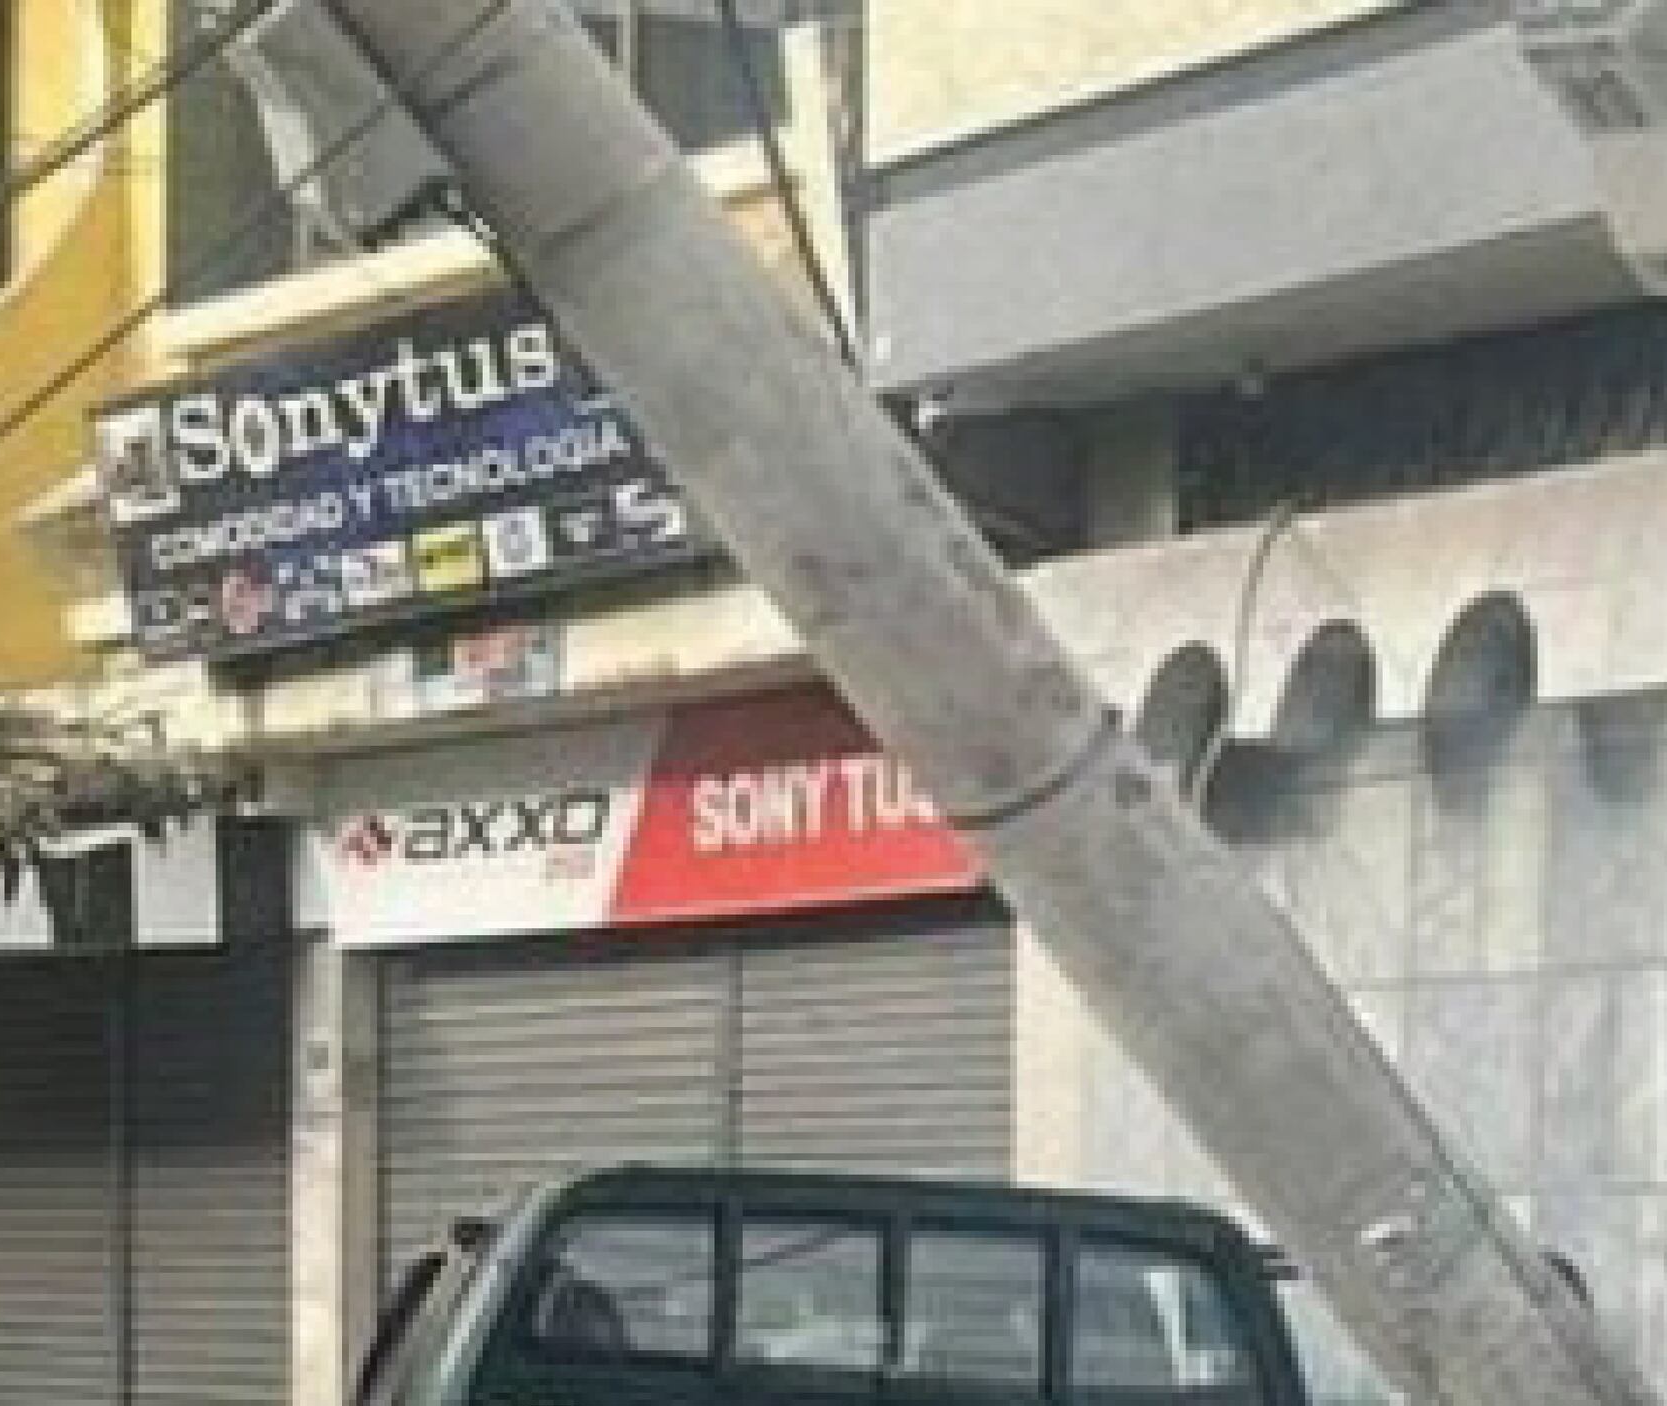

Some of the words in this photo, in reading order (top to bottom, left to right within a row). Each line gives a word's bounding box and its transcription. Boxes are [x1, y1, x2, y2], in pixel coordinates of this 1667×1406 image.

[170, 322, 561, 479] Sonytus
[346, 483, 374, 520] Y
[403, 791, 610, 860] axxo
[691, 754, 827, 853] SONY
